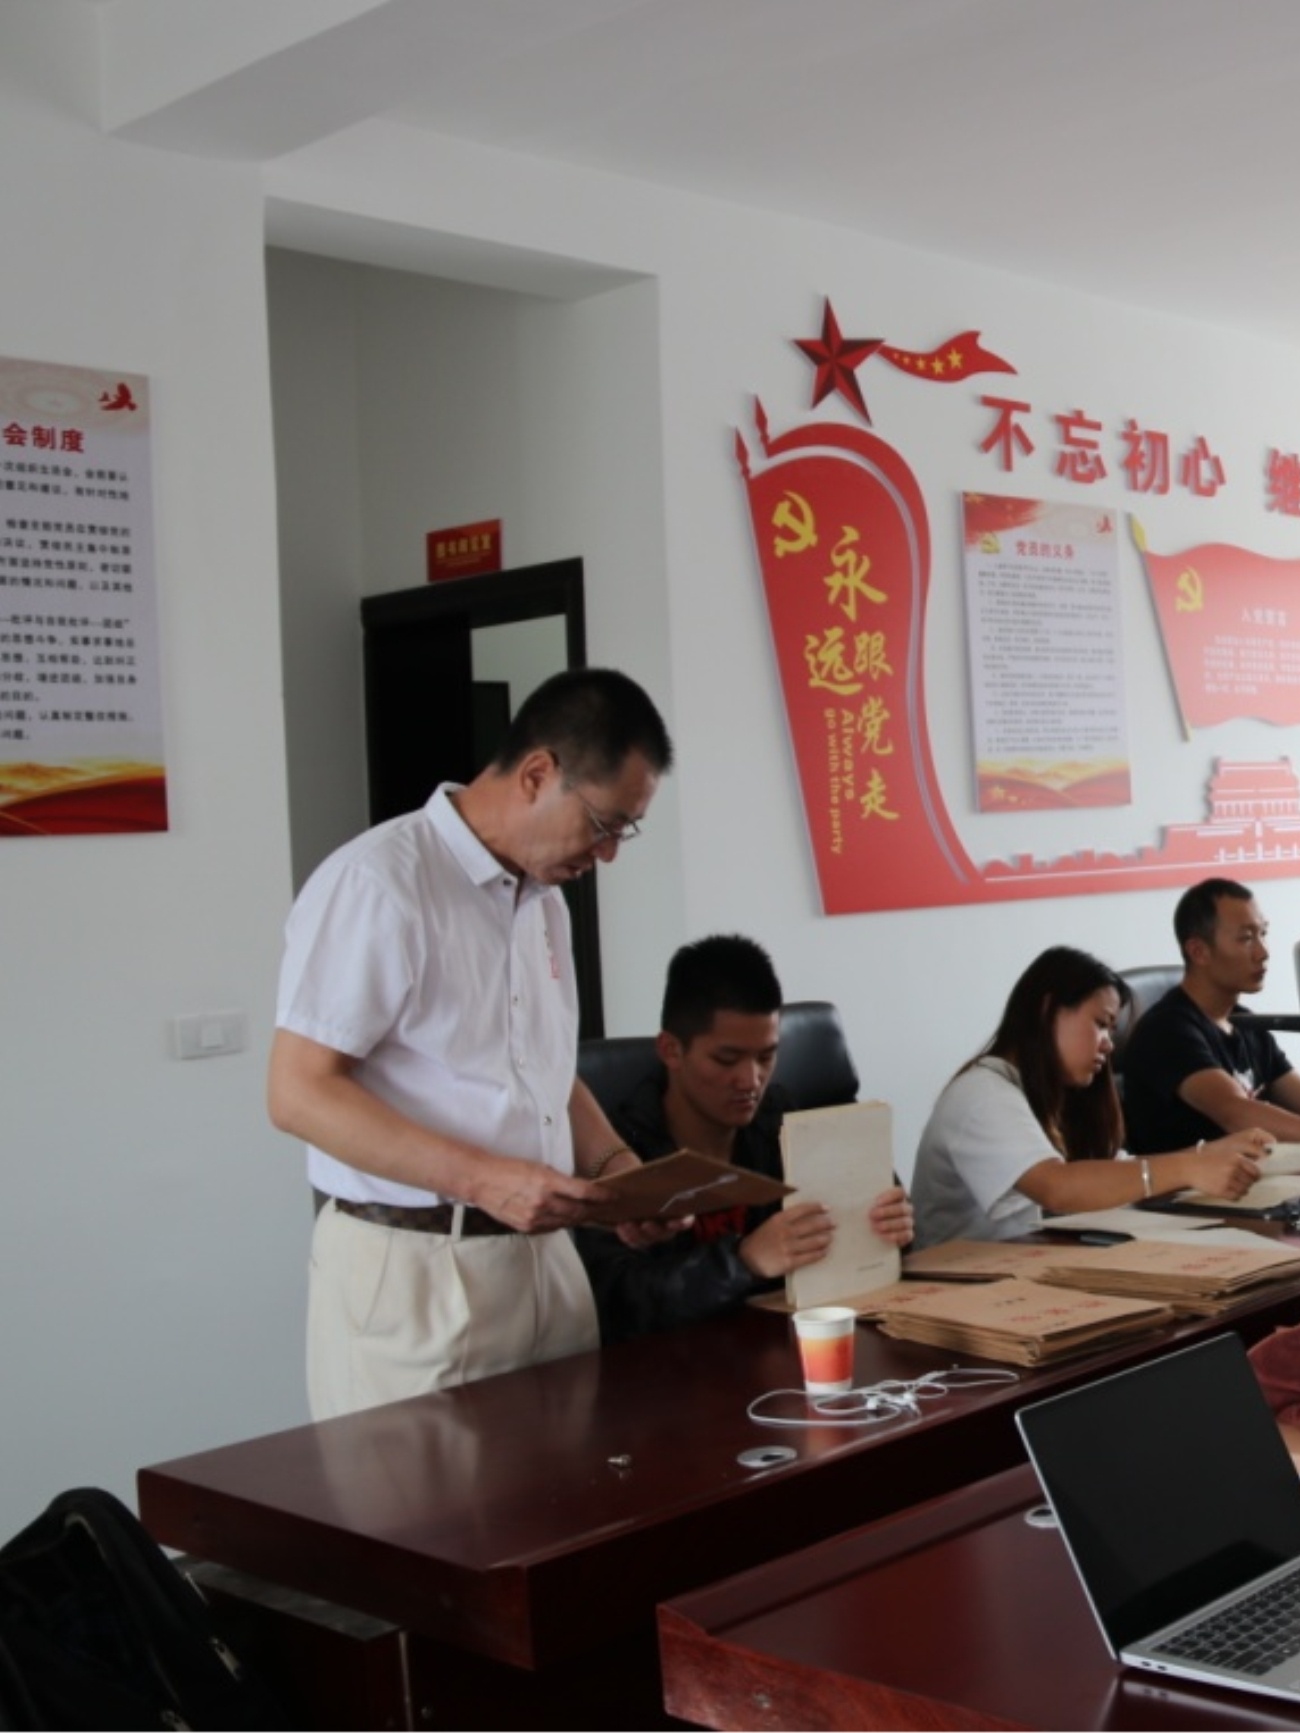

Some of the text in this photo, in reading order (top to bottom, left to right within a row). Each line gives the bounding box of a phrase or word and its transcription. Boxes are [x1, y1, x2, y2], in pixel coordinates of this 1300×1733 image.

[3, 422, 84, 453] 会制度
[978, 395, 1226, 497] 不忘初心
[824, 708, 843, 854] go with the party
[842, 707, 855, 801] Always
